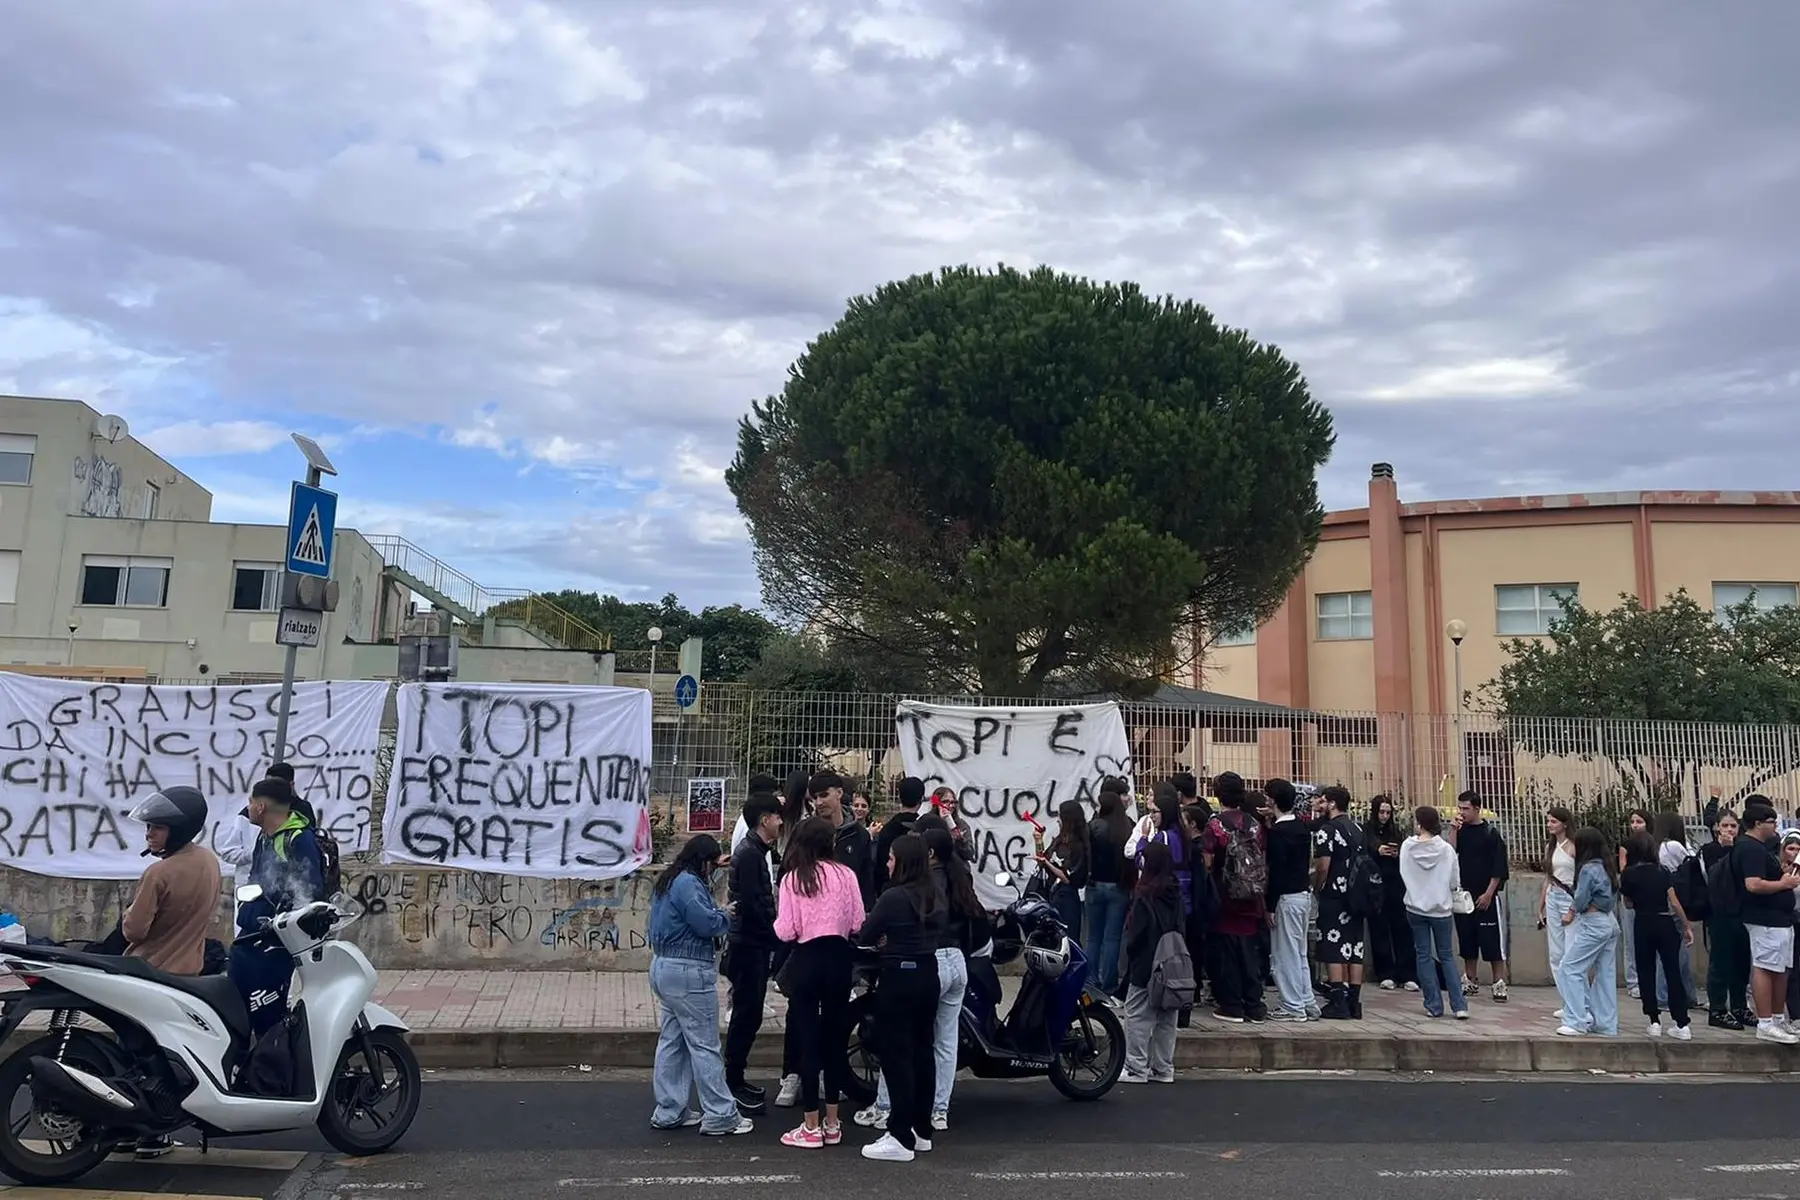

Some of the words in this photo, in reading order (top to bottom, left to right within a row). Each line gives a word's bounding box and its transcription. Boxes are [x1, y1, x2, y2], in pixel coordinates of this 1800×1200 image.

[284, 620, 317, 635] rialzato
[0, 720, 74, 755] DA
[415, 688, 429, 753] I
[442, 687, 575, 759] TOPI
[1048, 712, 1086, 755] E
[105, 759, 162, 798] HA
[401, 809, 627, 867] GRATIS
[1010, 1059, 1049, 1069] HONDA
